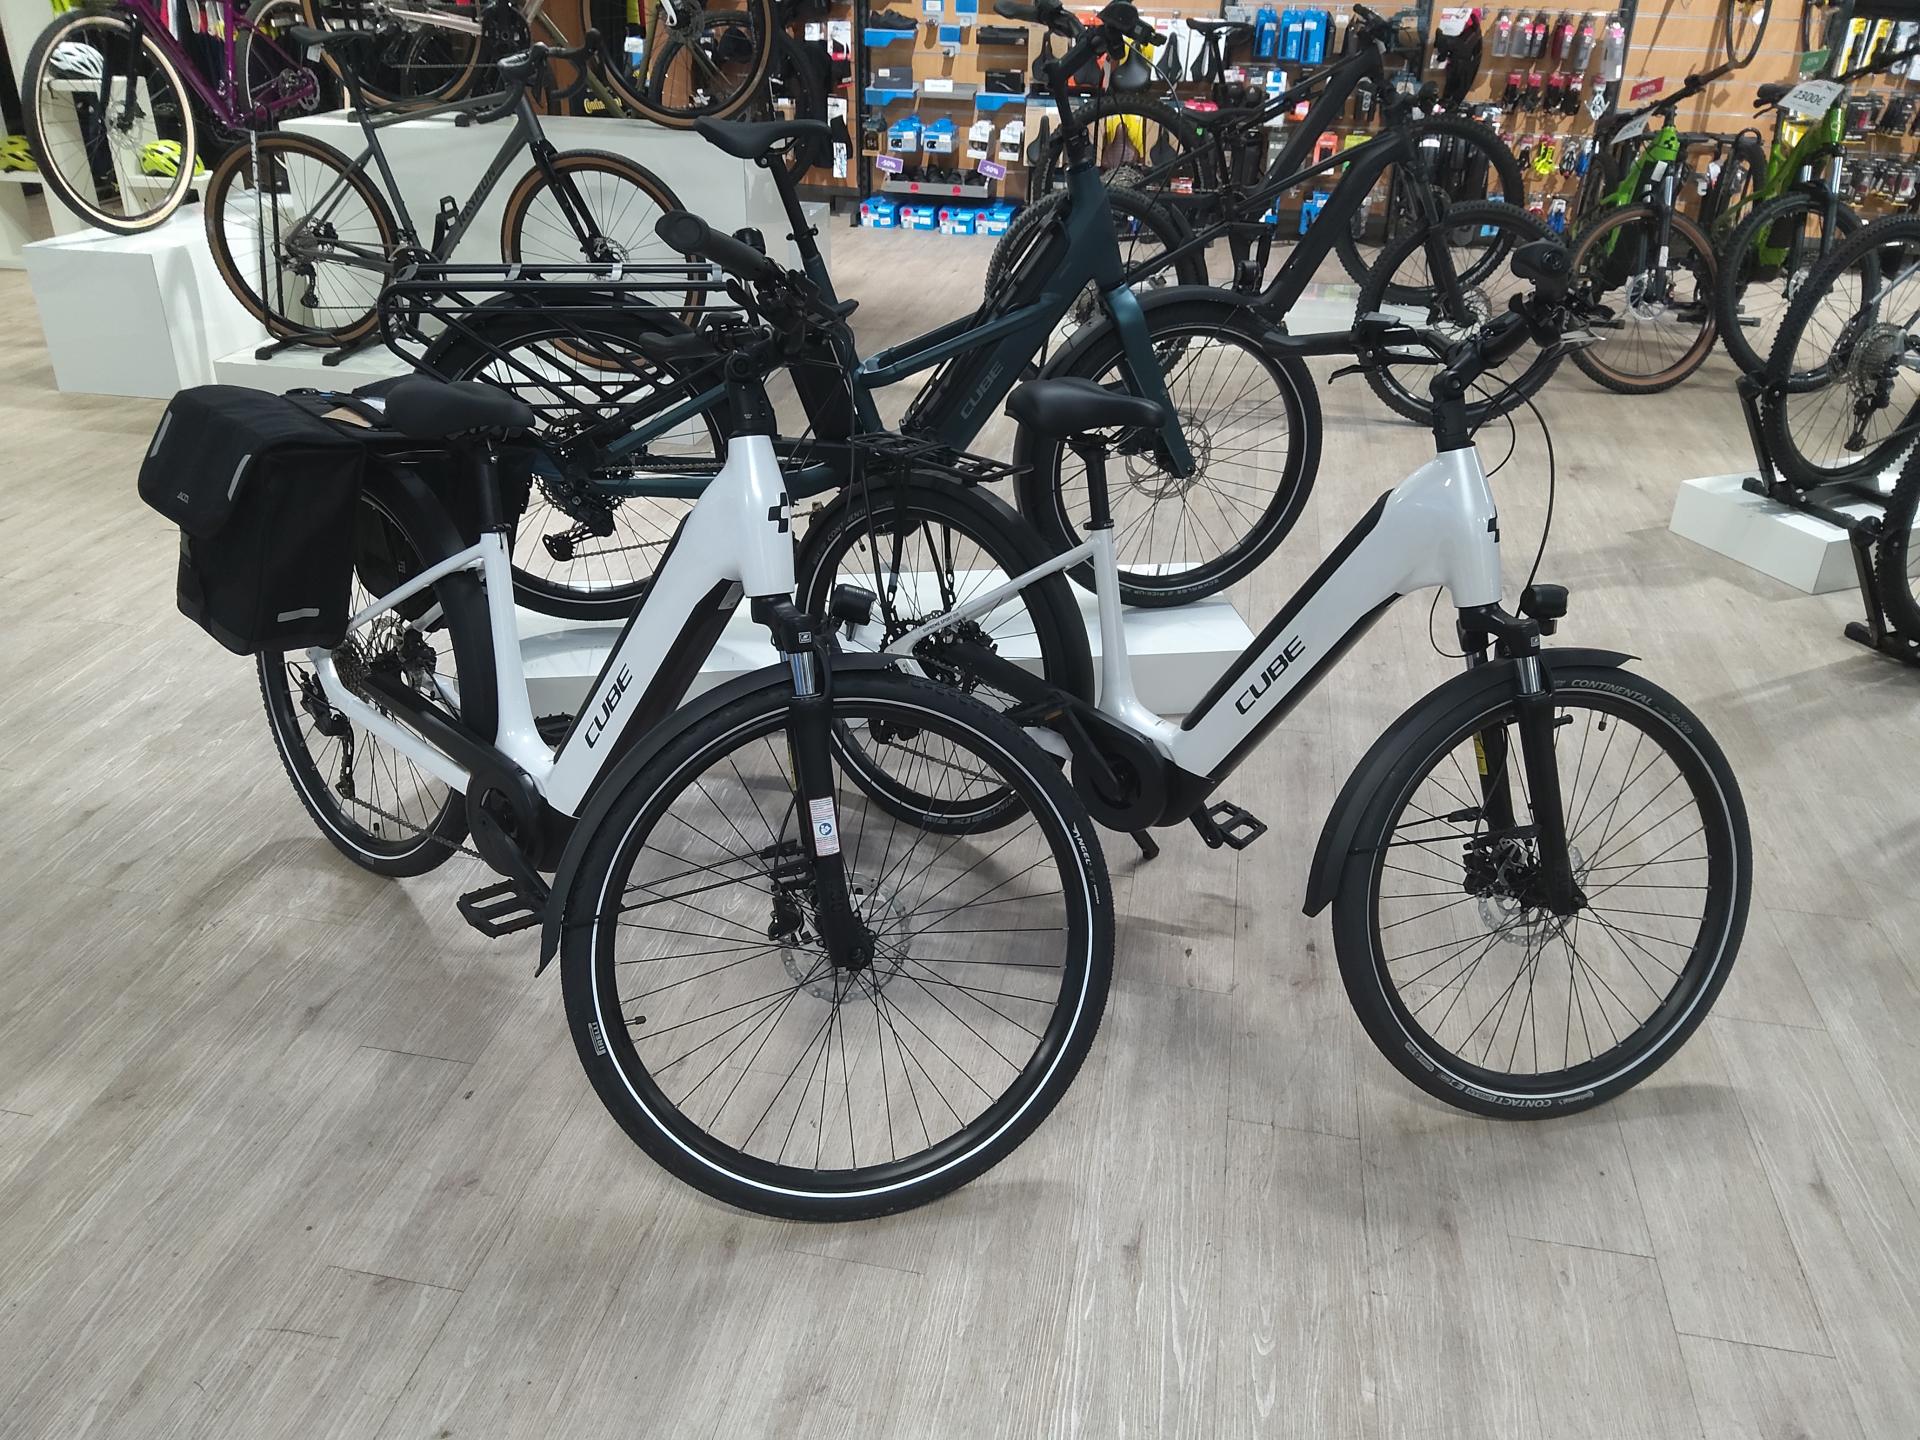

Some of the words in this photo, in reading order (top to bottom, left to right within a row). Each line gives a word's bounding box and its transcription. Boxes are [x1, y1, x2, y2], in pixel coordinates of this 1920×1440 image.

[1793, 90, 1825, 106] 2300€
[960, 360, 1004, 420] CUBE
[1235, 634, 1306, 715] CUBE
[1571, 679, 1653, 705] CONTINENTAL
[584, 662, 633, 749] CUBE
[1071, 821, 1092, 865] ANGEL
[588, 1021, 607, 1056] PIRELLI
[1465, 1087, 1498, 1102] URBAN
[1496, 1096, 1552, 1108] CONTACT
